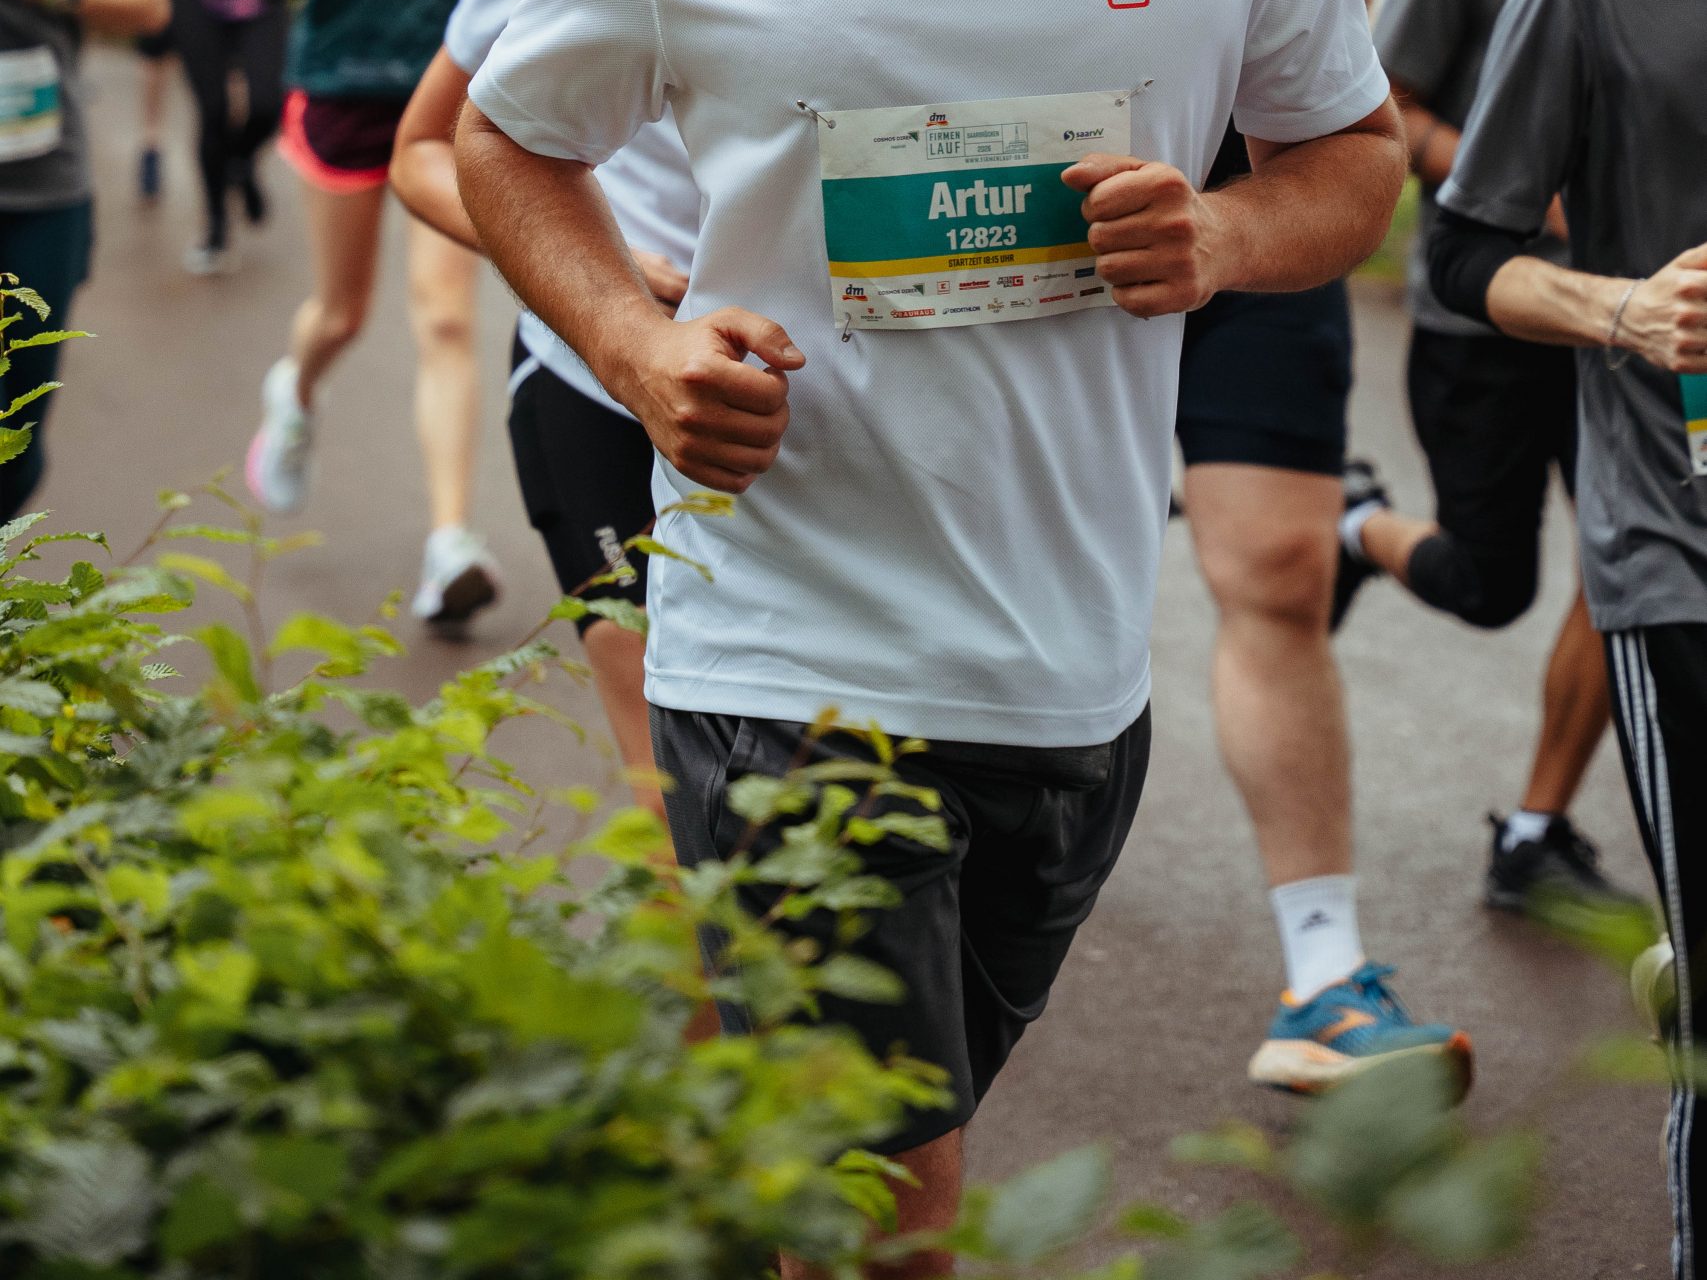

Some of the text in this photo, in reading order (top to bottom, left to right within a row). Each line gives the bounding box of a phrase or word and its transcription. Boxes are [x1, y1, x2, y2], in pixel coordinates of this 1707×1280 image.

[929, 112, 947, 122] dm
[929, 131, 960, 142] FIRMEN
[930, 142, 961, 156] LAUF
[928, 179, 1032, 220] Artur
[946, 225, 1018, 251] 12823
[948, 256, 982, 268] STARTZEIT
[1001, 254, 1015, 264] UHR
[845, 283, 865, 295] dm
